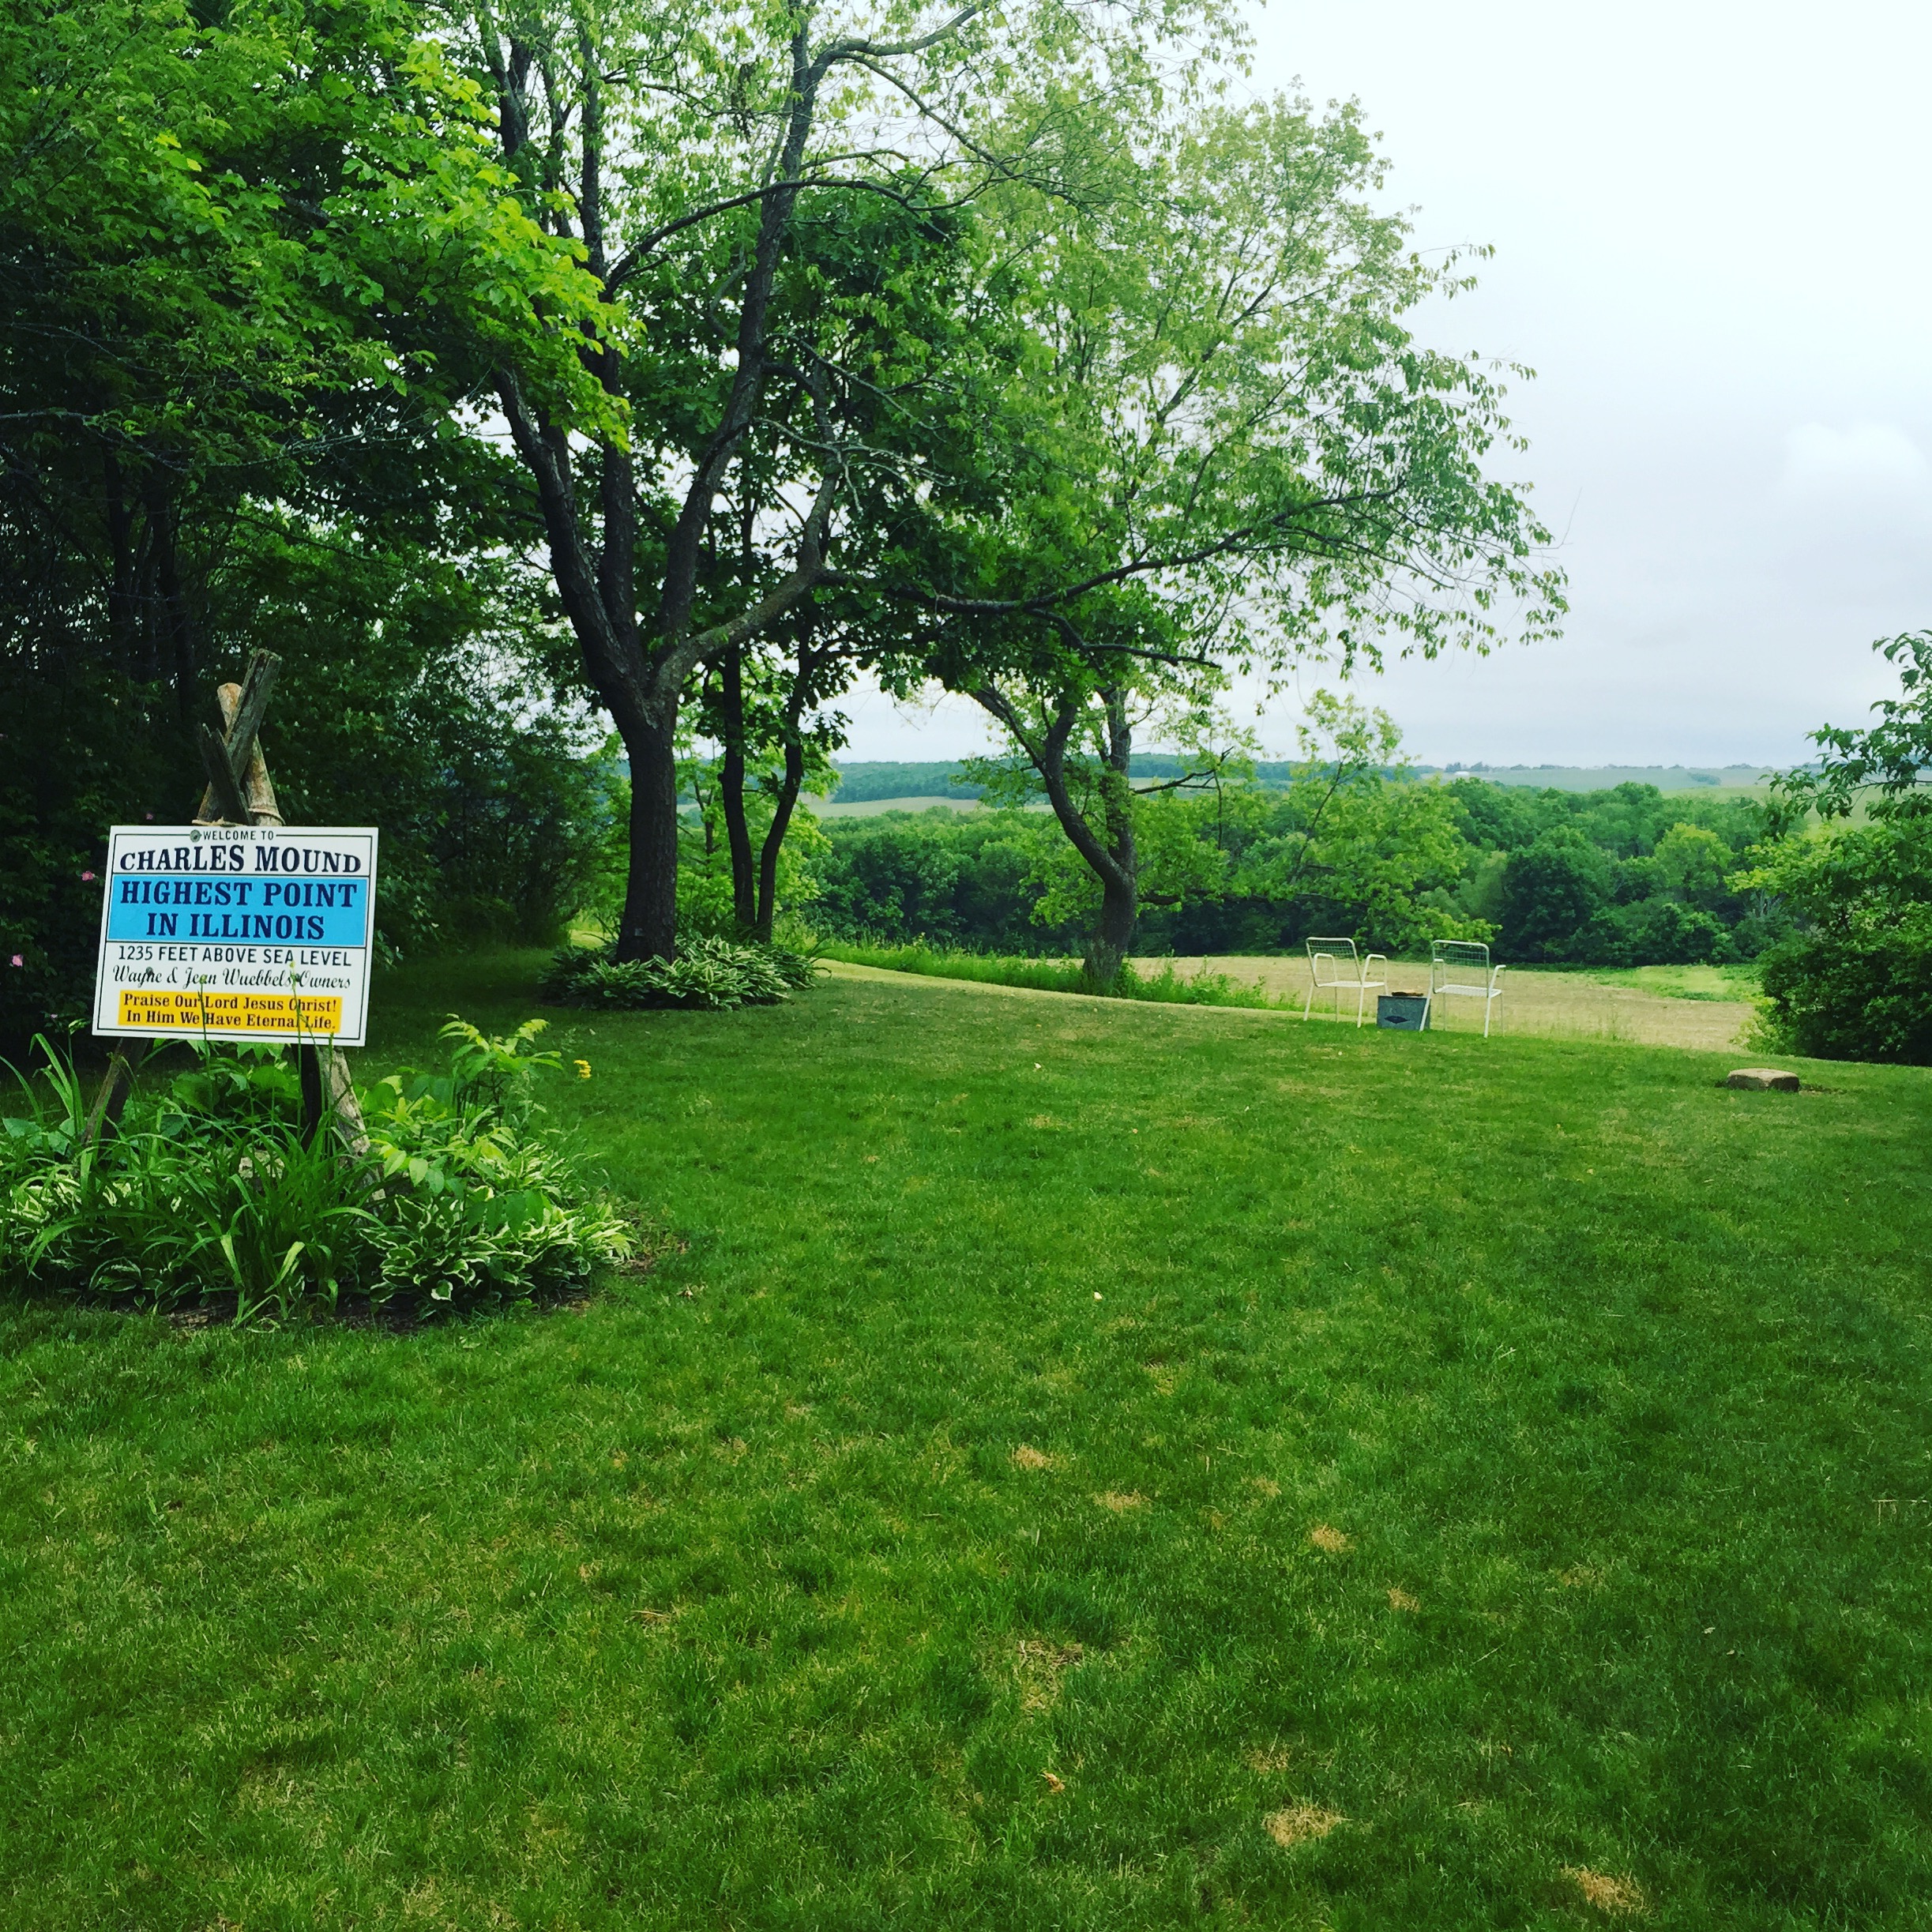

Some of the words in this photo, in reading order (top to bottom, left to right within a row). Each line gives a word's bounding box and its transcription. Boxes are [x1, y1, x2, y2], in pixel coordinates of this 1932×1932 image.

[203, 830, 256, 840] WELCOME
[261, 831, 274, 840] TO
[120, 844, 244, 871] CHARLES
[255, 846, 361, 873] MOUND
[120, 881, 252, 905] HIGHEST
[264, 883, 358, 908] POINT
[147, 913, 179, 936] IN
[190, 915, 325, 939] ILLINOIS
[118, 946, 153, 960] 1235
[159, 947, 197, 961] FEET
[202, 949, 255, 963] ABOVE
[264, 949, 293, 964] SEA
[301, 952, 351, 965] LEVEL
[113, 965, 162, 989] Wayne
[167, 967, 179, 984] &
[124, 994, 170, 1007] Praise
[175, 996, 199, 1008] Our
[205, 996, 238, 1009] Lord
[243, 998, 284, 1010] Jesus
[288, 998, 336, 1012] Christ!
[126, 1010, 140, 1022] In
[145, 1011, 175, 1024] Him
[180, 1012, 199, 1024] We
[205, 1013, 242, 1025] Have
